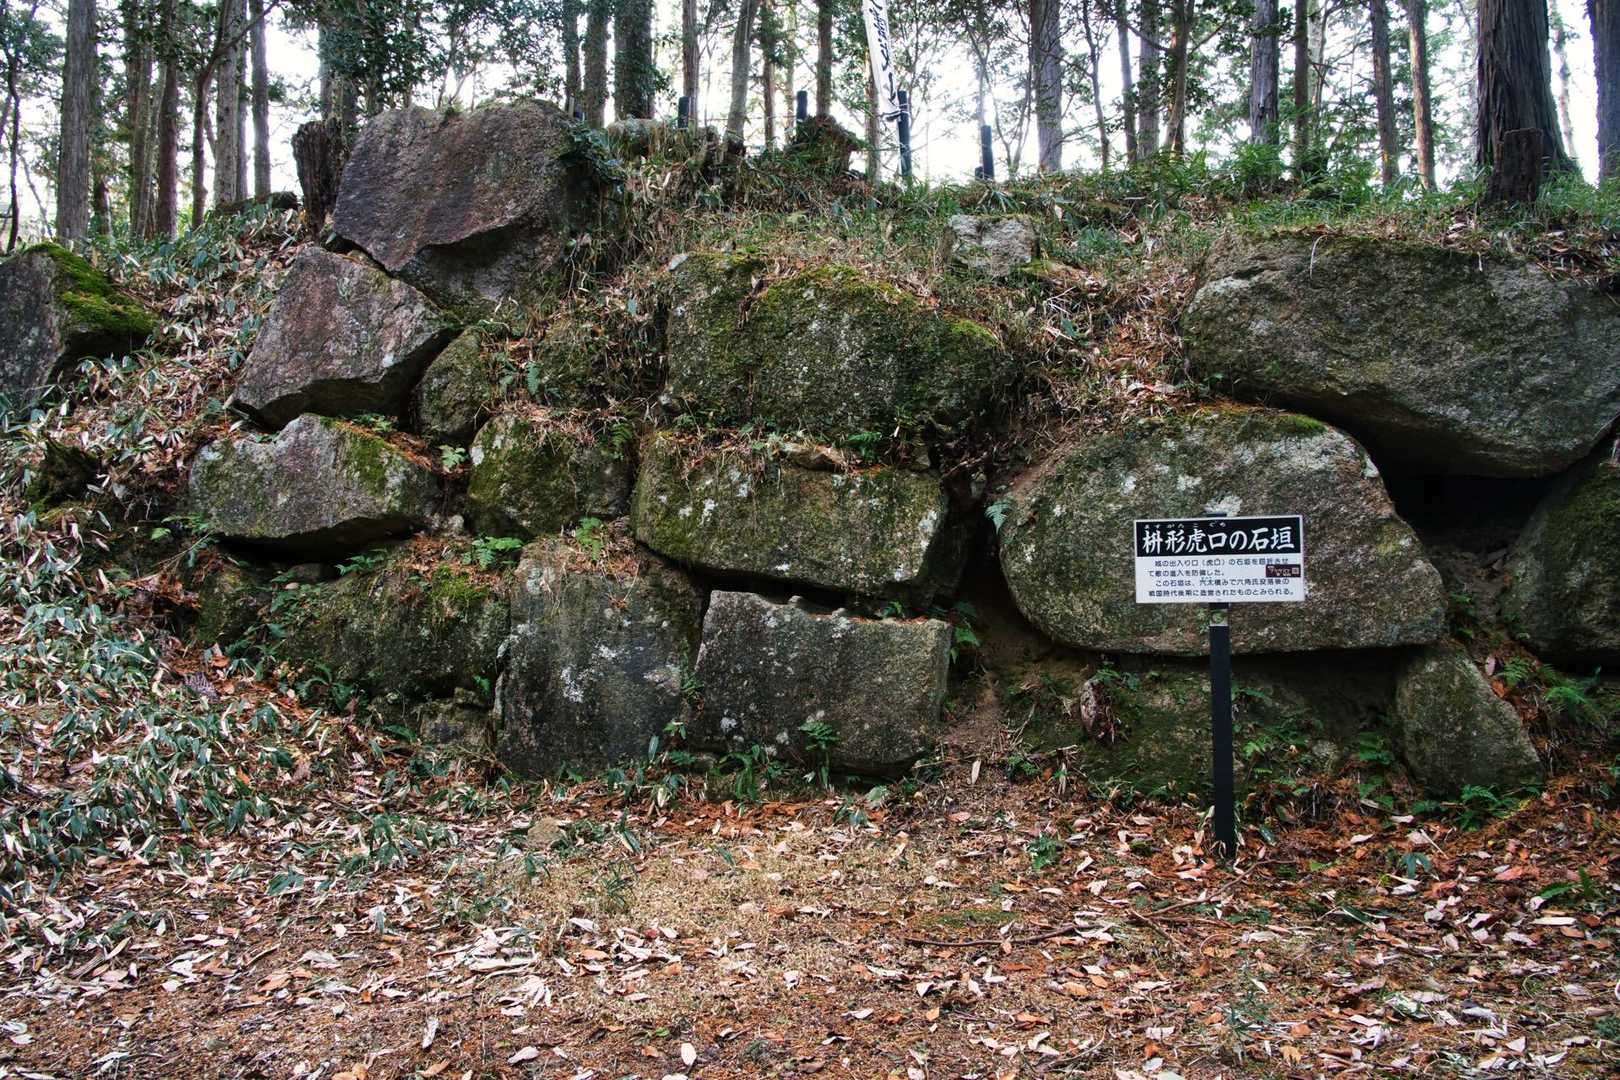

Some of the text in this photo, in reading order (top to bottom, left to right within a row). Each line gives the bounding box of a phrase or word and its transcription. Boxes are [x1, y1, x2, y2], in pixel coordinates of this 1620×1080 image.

[1142, 526, 1295, 554] 枡形虎口の石垣
